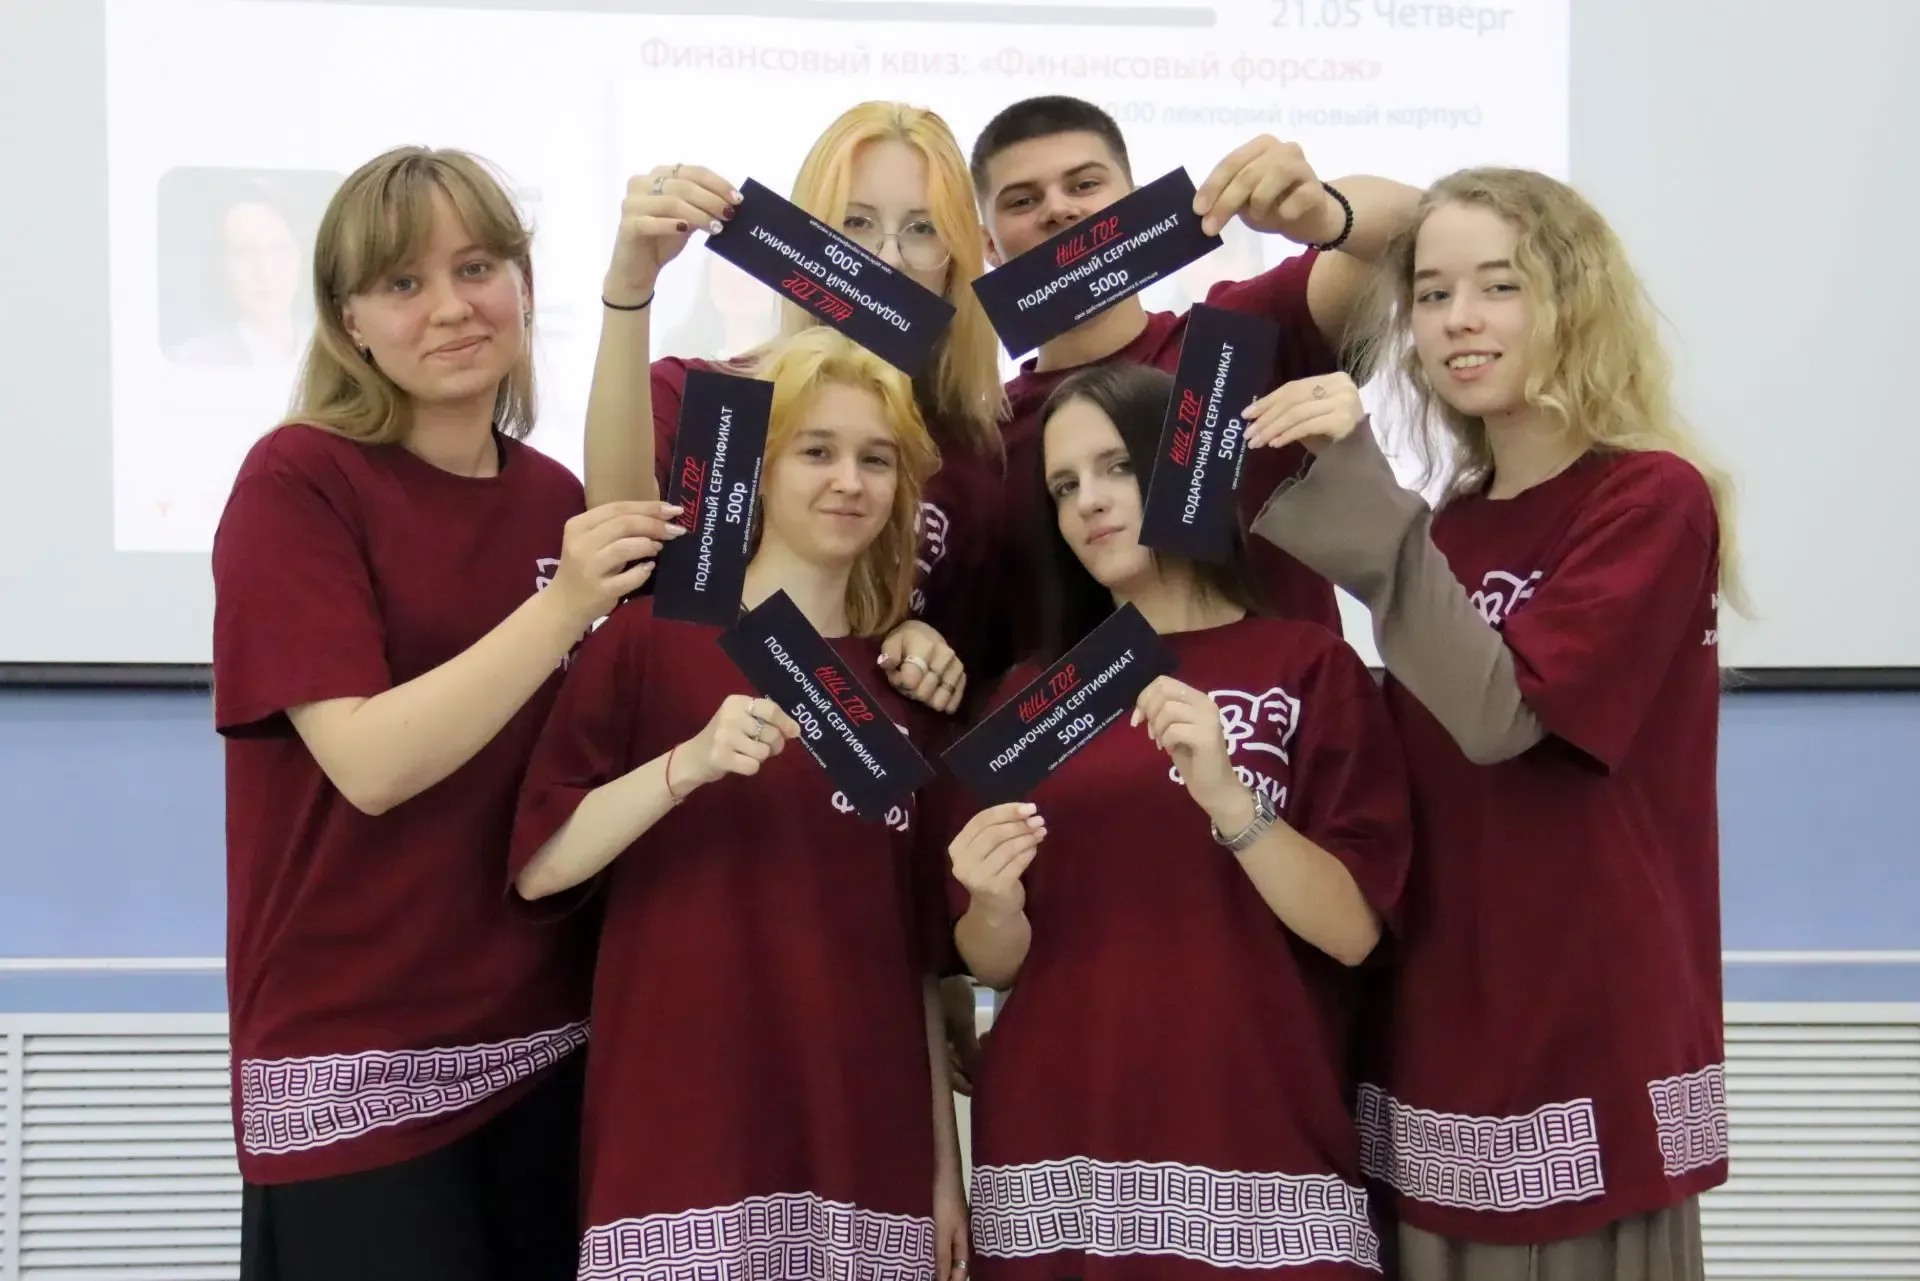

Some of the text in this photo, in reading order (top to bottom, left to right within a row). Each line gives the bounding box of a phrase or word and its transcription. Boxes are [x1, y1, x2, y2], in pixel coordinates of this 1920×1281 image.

[1270, 0, 1515, 38] 21.05 Четверг
[640, 37, 871, 75] Финансовый
[880, 49, 968, 76] квиз:
[1231, 50, 1383, 89] форсаж»
[1161, 103, 1281, 127] лекторий
[1289, 103, 1379, 127] (новый
[1386, 105, 1482, 130] корпус)
[1090, 215, 1118, 240] TOP
[749, 225, 910, 331] ПОДАРОЧНЫЙ СЕРТИФИКАТ
[824, 244, 862, 276] 500р
[1017, 213, 1178, 311] ПОДАРОЧНЫЙ СЕРТИФИКАТ
[781, 278, 816, 301] TOP
[1088, 269, 1128, 296] 500р
[1178, 388, 1198, 424] TOP
[1182, 342, 1233, 523] ПОДАРОЧНЫЙ СЕРТИФИКАТ
[1217, 418, 1242, 459] 500р
[681, 456, 701, 491] TOP
[694, 405, 732, 591] ПОДАРОЧНЫЙ СЕРТИФИКАТ
[725, 482, 747, 524] 500р
[1048, 663, 1076, 696] TOP
[764, 635, 831, 712] ПОДАРОЧНЫЙ
[827, 711, 886, 778] СЕРТИФИКАТ
[791, 702, 822, 739] 500р
[846, 695, 875, 720] TOP
[989, 649, 1135, 771] ПОДАРОЧНЫЙ СЕРТИФИКАТ
[1056, 713, 1094, 744] 500р
